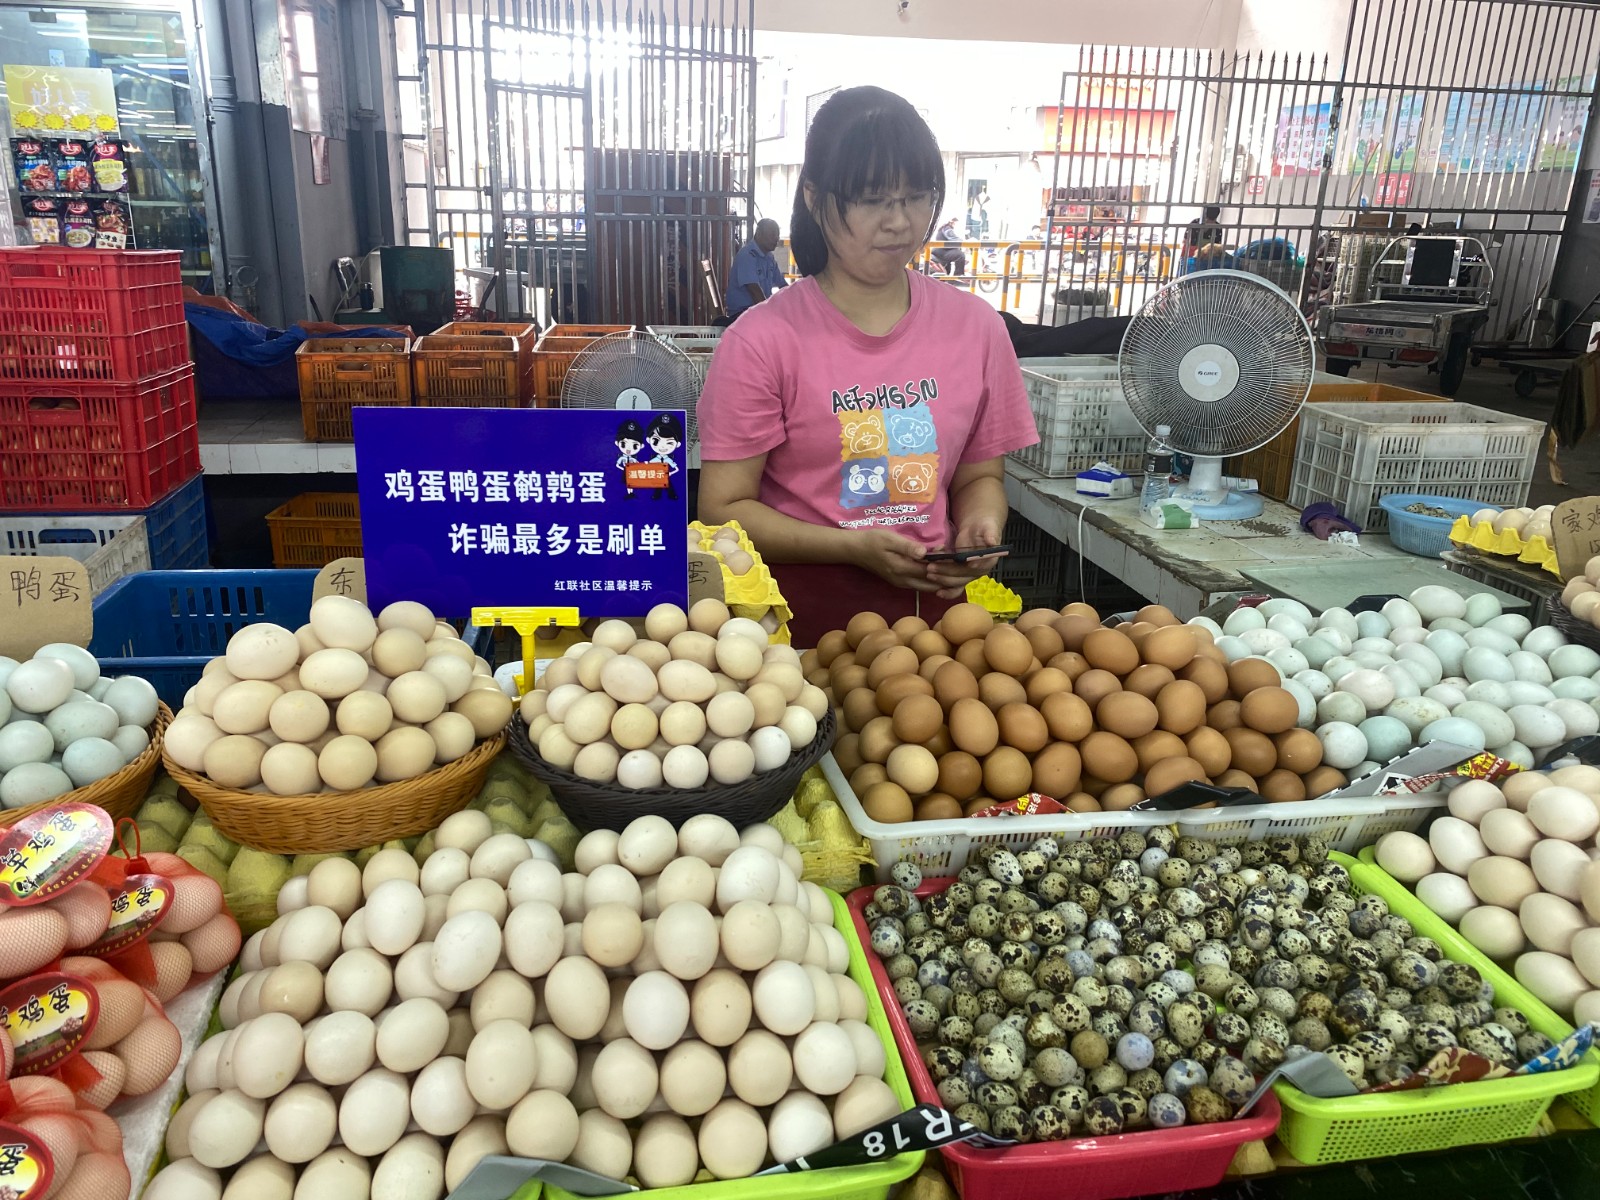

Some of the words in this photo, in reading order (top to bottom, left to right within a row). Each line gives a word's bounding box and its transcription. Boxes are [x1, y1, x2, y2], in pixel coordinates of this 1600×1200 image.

[384, 469, 606, 503] 鸡蛋鸭蛋鹌鹑蛋
[628, 470, 665, 479] 温馨提示
[448, 522, 667, 556] 诈骗最多是刷单
[10, 566, 81, 607] 鸭蛋
[554, 579, 653, 592] 红联社区温馨提示
[0, 811, 77, 874] 草鸡蛋
[920, 1107, 975, 1142] R
